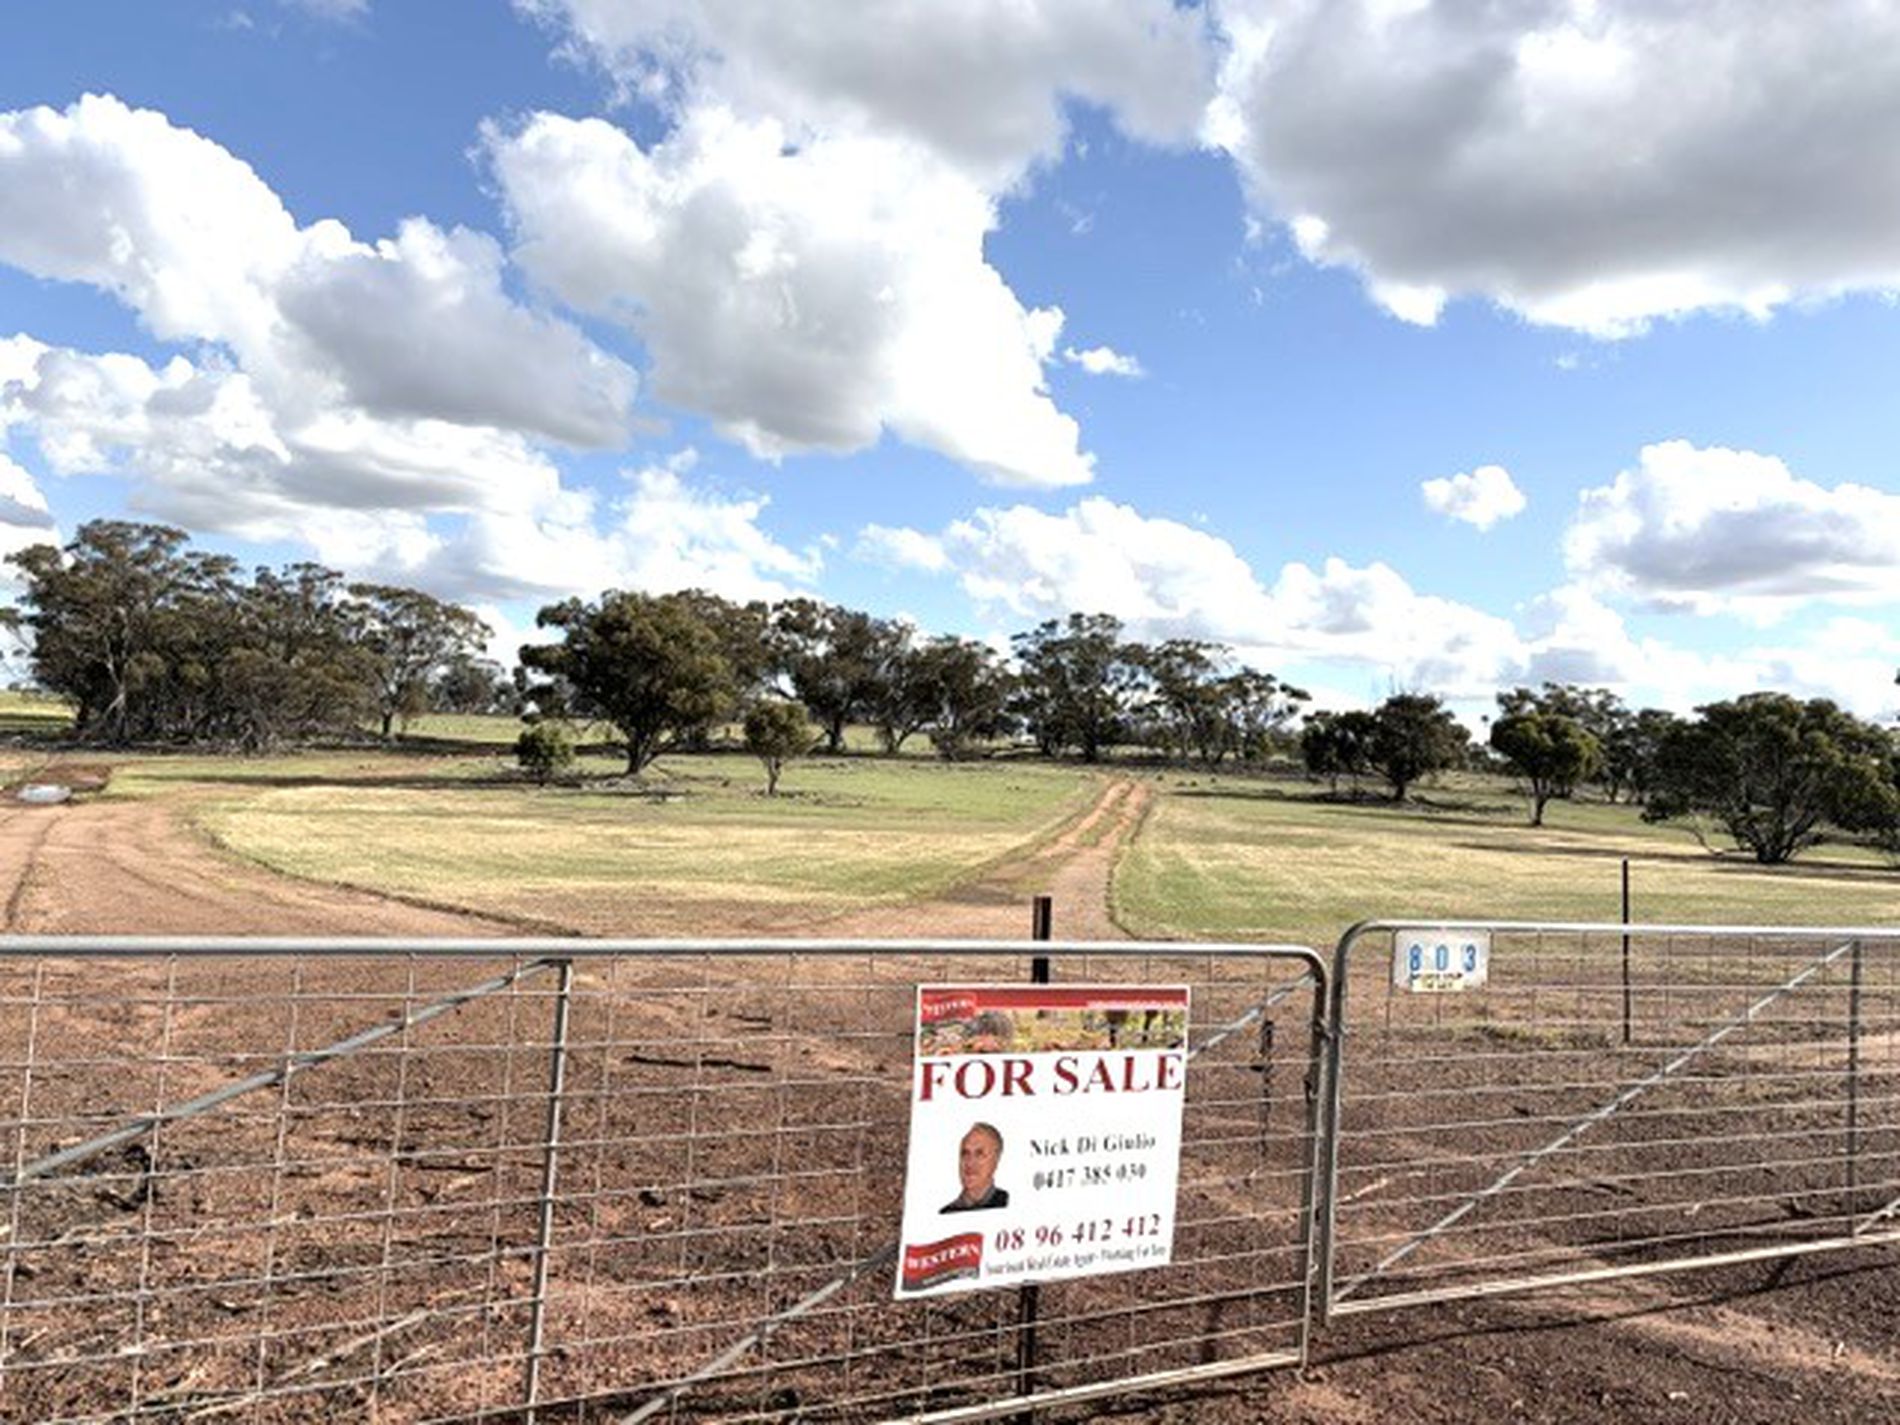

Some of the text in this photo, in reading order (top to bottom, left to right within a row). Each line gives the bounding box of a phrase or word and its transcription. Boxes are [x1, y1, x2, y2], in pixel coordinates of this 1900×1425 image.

[1410, 944, 1476, 972] 803
[919, 1054, 1182, 1101] FOR SALE
[1030, 1138, 1070, 1157] Nick
[1077, 1135, 1097, 1154] Di
[995, 1213, 1160, 1252] 08 96 412 412
